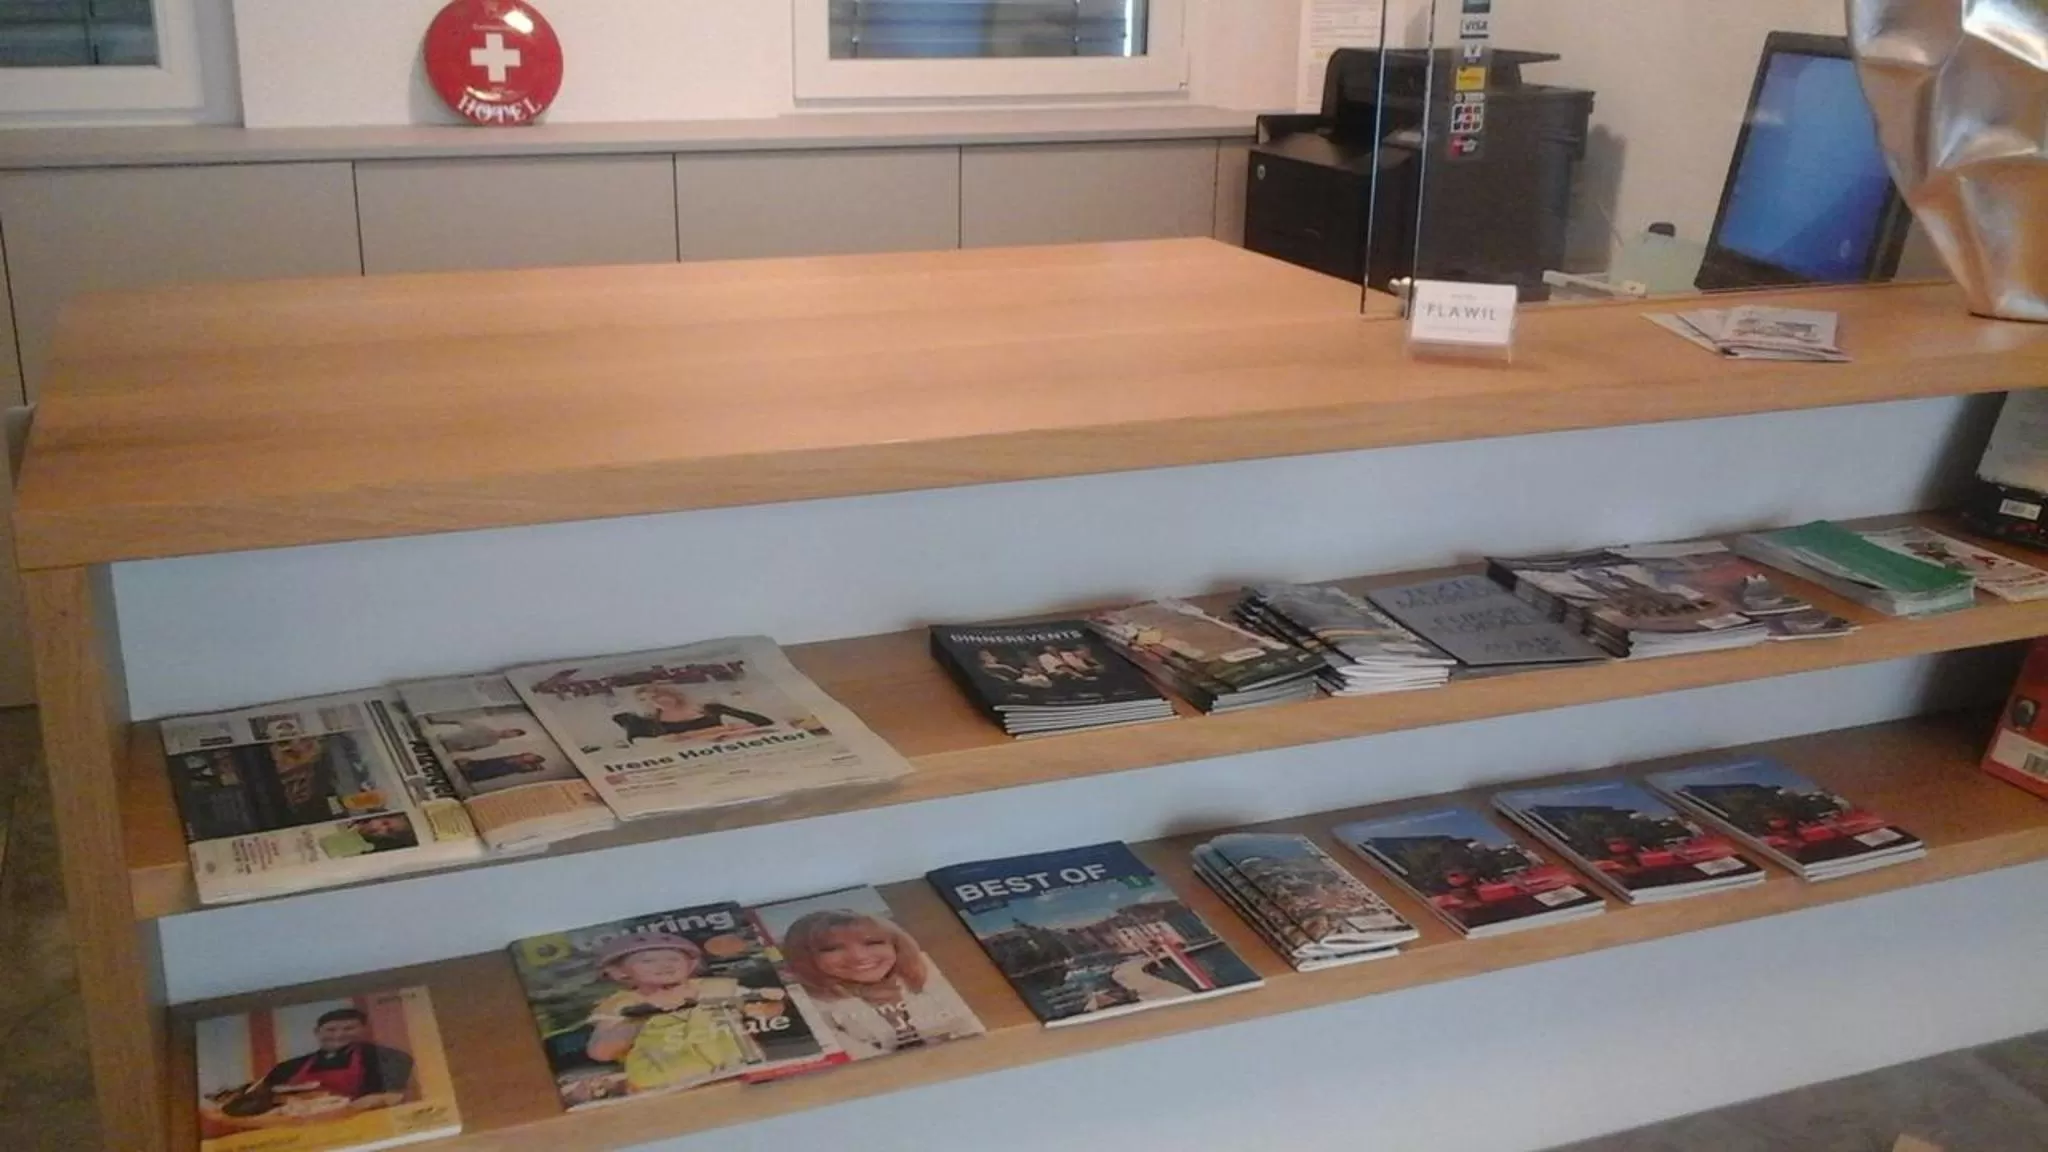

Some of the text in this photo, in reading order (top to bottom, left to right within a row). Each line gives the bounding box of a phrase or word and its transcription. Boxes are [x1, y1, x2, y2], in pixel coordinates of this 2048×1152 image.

[1464, 20, 1488, 31] VISA
[457, 95, 542, 123] HOTEL
[1427, 303, 1497, 320] FLAWIL
[950, 629, 1083, 644] DINNEREVENTS
[604, 732, 806, 773] Irene Hofstetter
[955, 871, 1051, 902] BEST
[1060, 863, 1107, 884] OF
